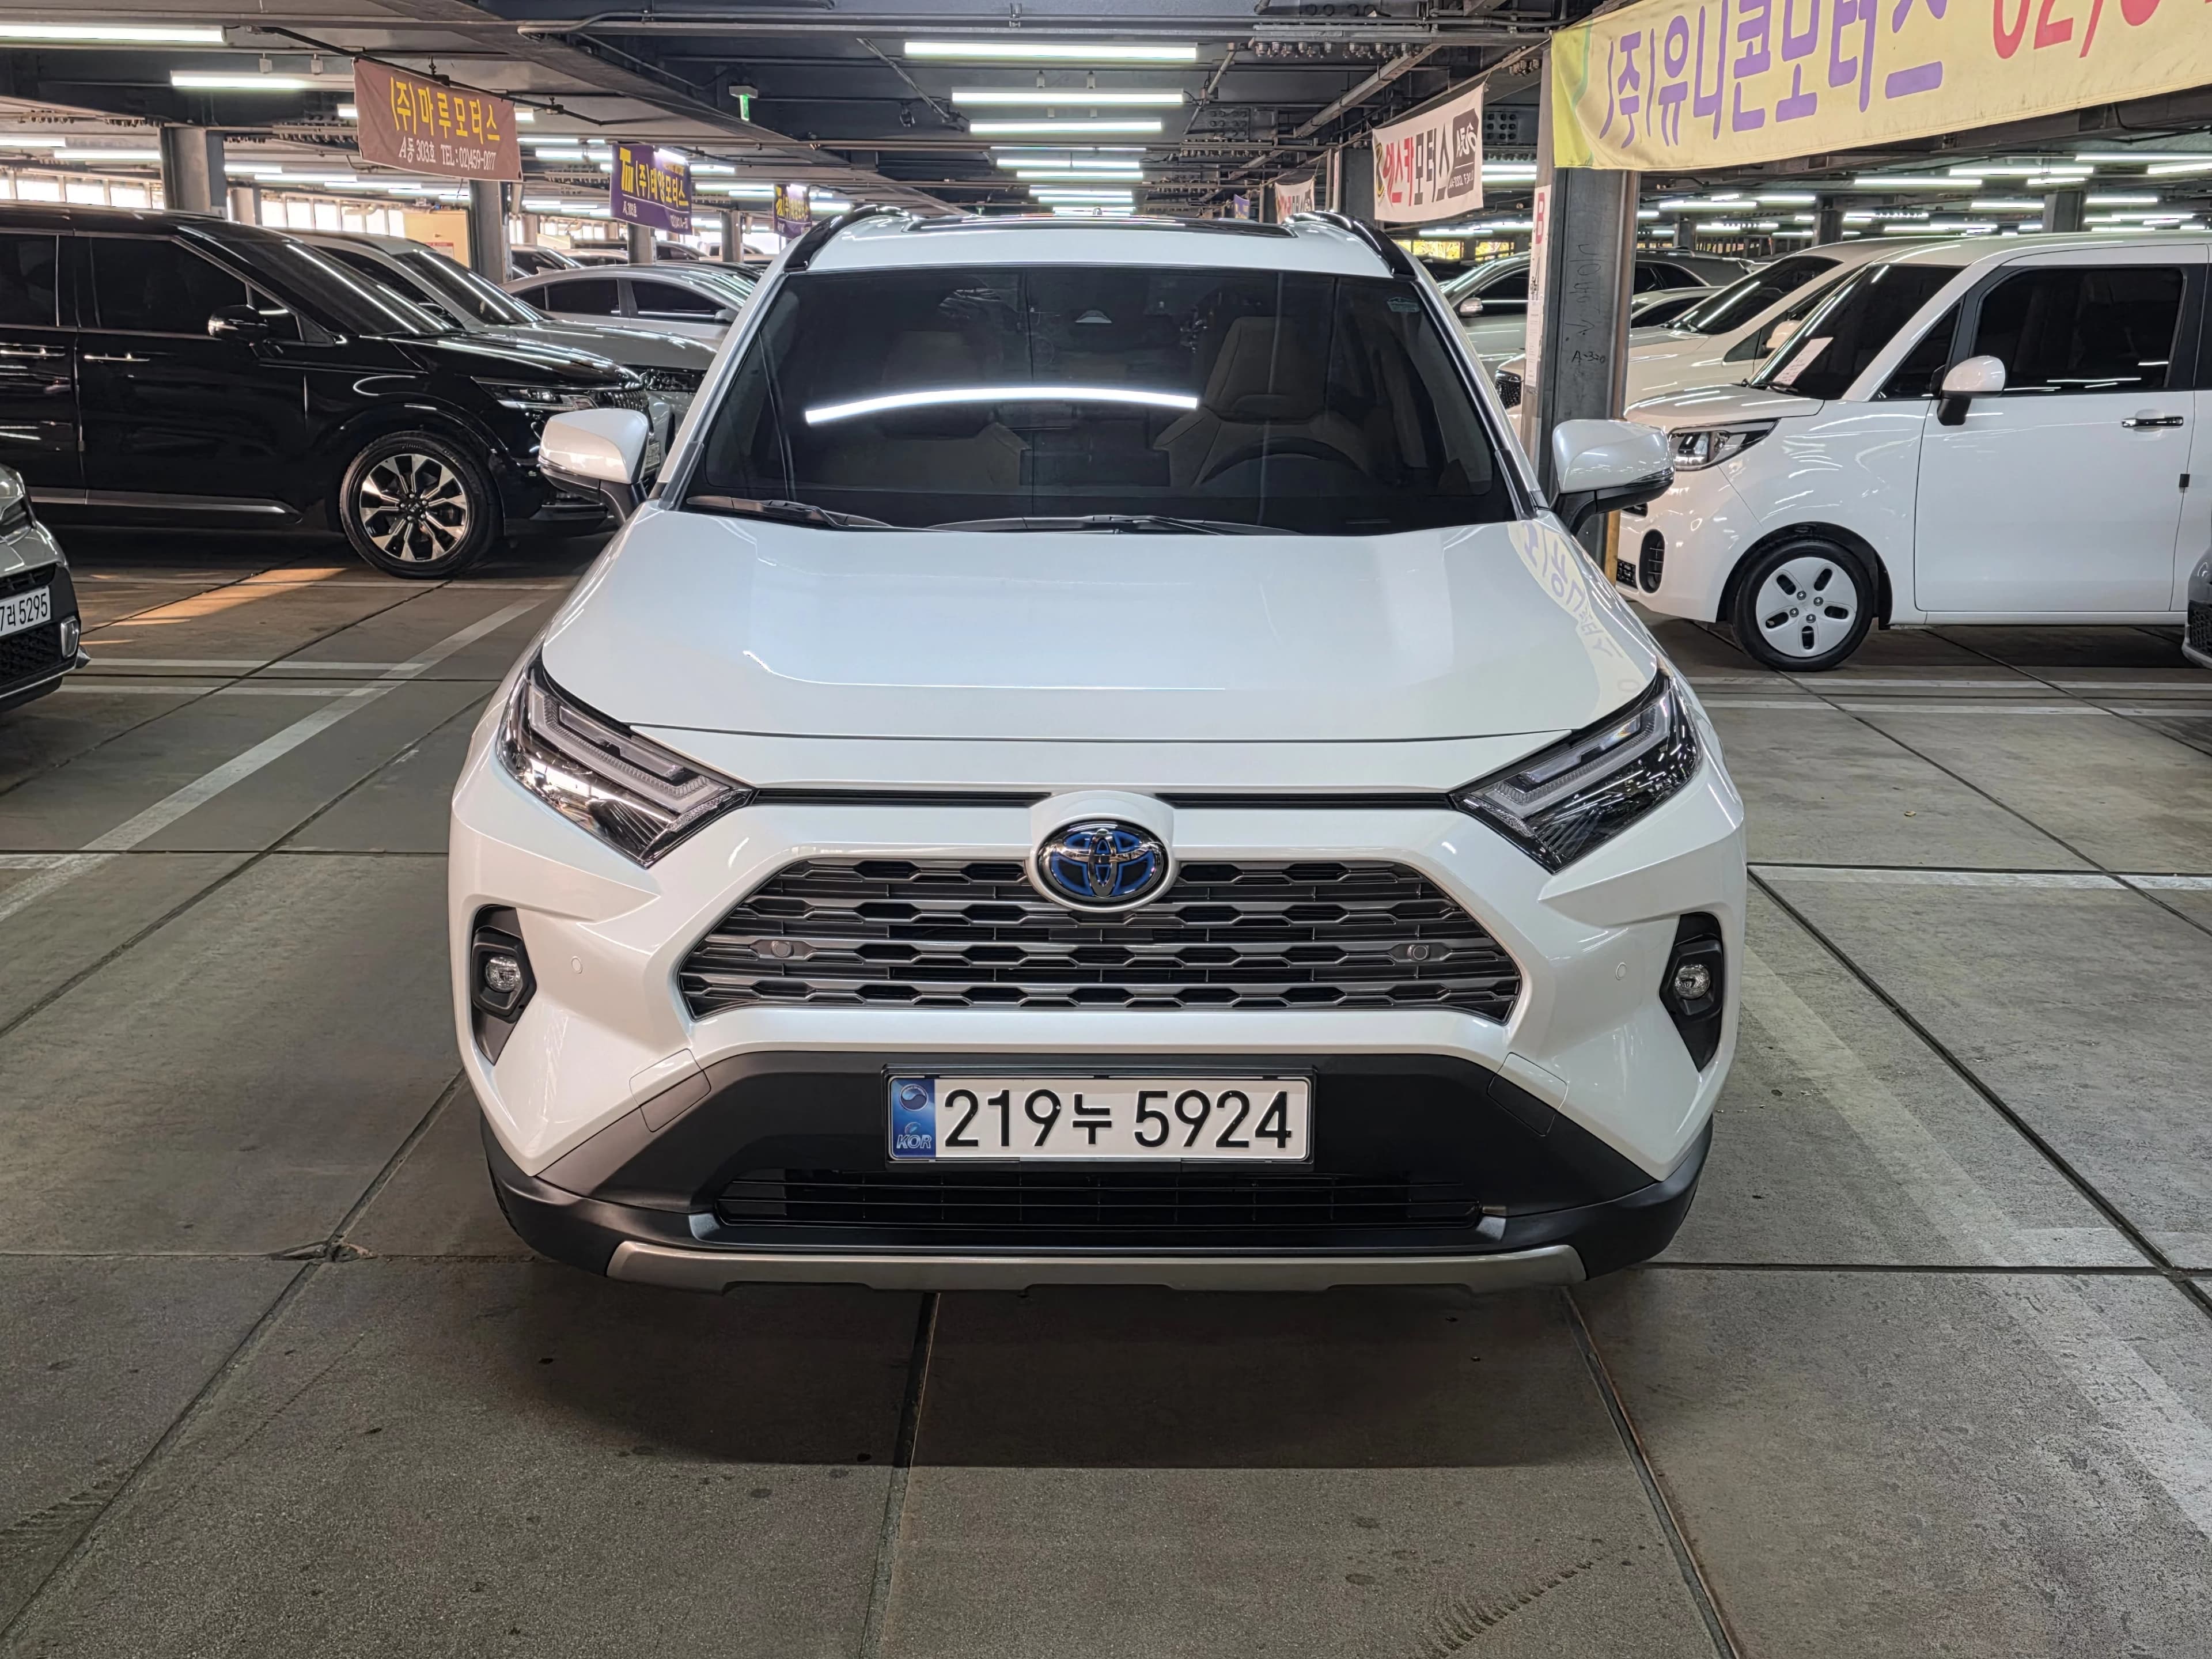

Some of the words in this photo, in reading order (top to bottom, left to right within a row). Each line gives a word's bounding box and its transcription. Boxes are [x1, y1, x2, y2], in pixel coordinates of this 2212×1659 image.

[1599, 0, 1947, 149] (주)유니콘모터스
[391, 77, 500, 145] (주)마루모터스
[635, 160, 690, 208] (주)태양모터스
[1535, 192, 1545, 244] B
[19, 593, 48, 625] 5295
[896, 1134, 932, 1149] KOR
[944, 1089, 1113, 1148] 219누
[1133, 1089, 1293, 1149] 5924
